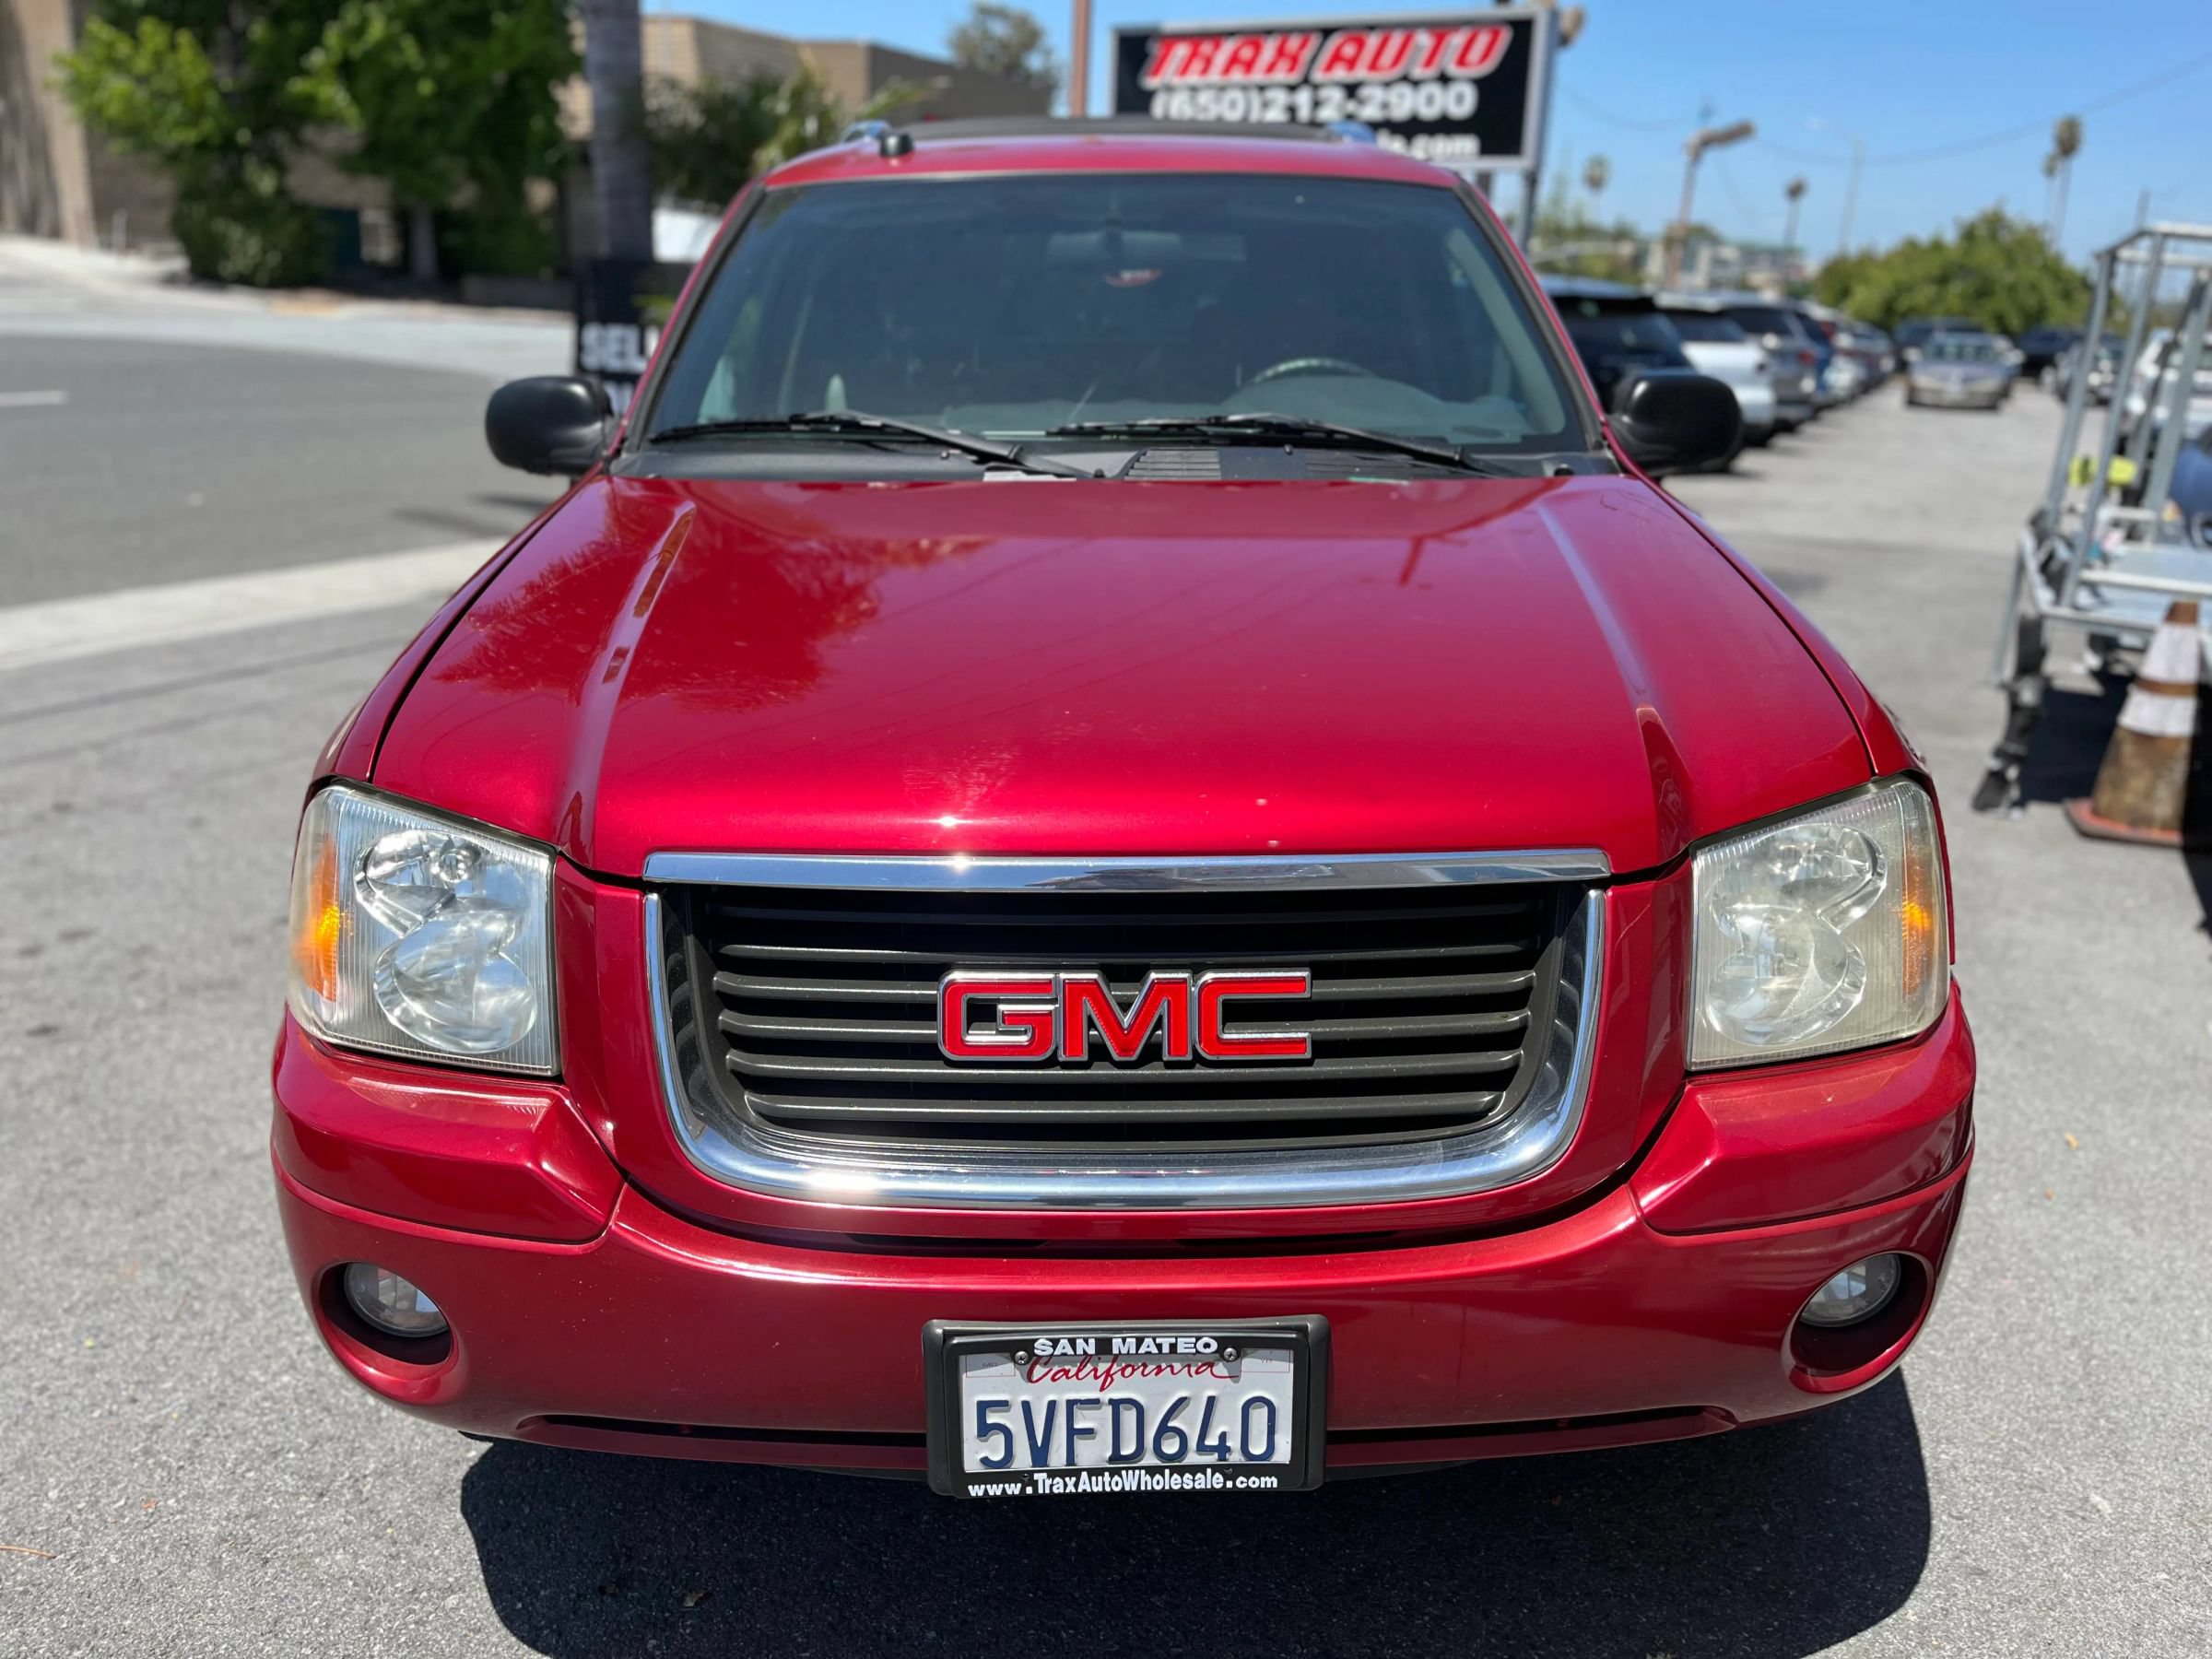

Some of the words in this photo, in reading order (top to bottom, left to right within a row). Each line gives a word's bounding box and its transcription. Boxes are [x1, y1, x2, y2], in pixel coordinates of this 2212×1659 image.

[1141, 34, 1319, 87] TRAX
[1312, 26, 1511, 77] AUTO
[1152, 82, 1477, 122] (650)212-2900
[938, 969, 1312, 1061] GMC
[1033, 1338, 1096, 1356] SAN
[1112, 1337, 1218, 1355] MATEO
[1026, 1356, 1240, 1392] California
[976, 1395, 1277, 1468] 5VFD640
[968, 1469, 1277, 1497] www.TraxAutoWholesale.com
